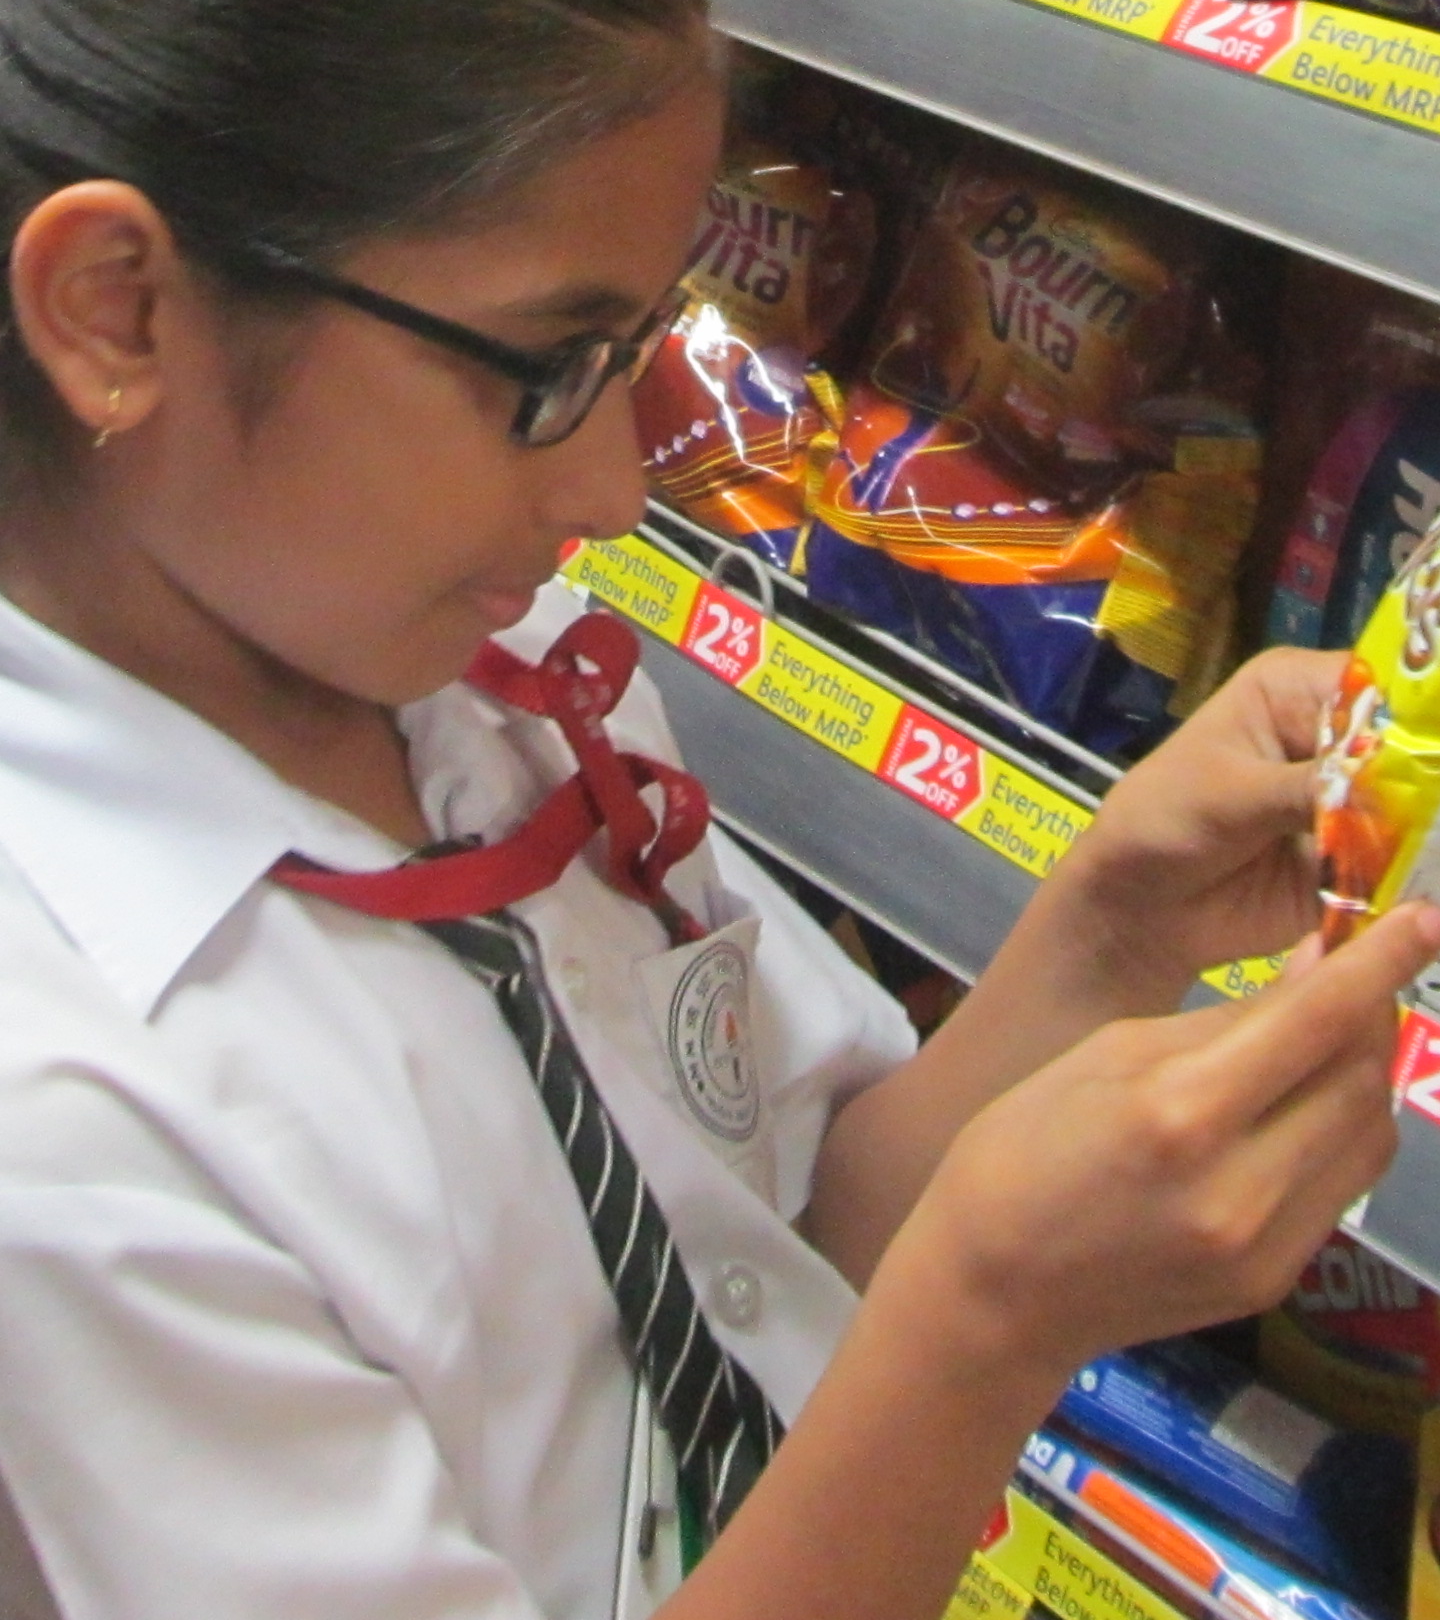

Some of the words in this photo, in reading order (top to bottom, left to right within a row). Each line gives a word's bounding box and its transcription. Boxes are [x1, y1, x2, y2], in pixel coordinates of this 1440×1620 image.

[1219, 35, 1265, 68] OFF
[1292, 54, 1378, 101] Below
[972, 195, 1141, 331] Bourn
[977, 257, 1081, 374] Vita
[579, 560, 628, 606] Below
[692, 602, 751, 667] 2%
[714, 650, 743, 681] OFF
[769, 640, 874, 726] Everything
[756, 677, 812, 729] Below
[895, 727, 972, 796] 2%
[925, 781, 960, 814] OFF
[979, 810, 1041, 864] Below
